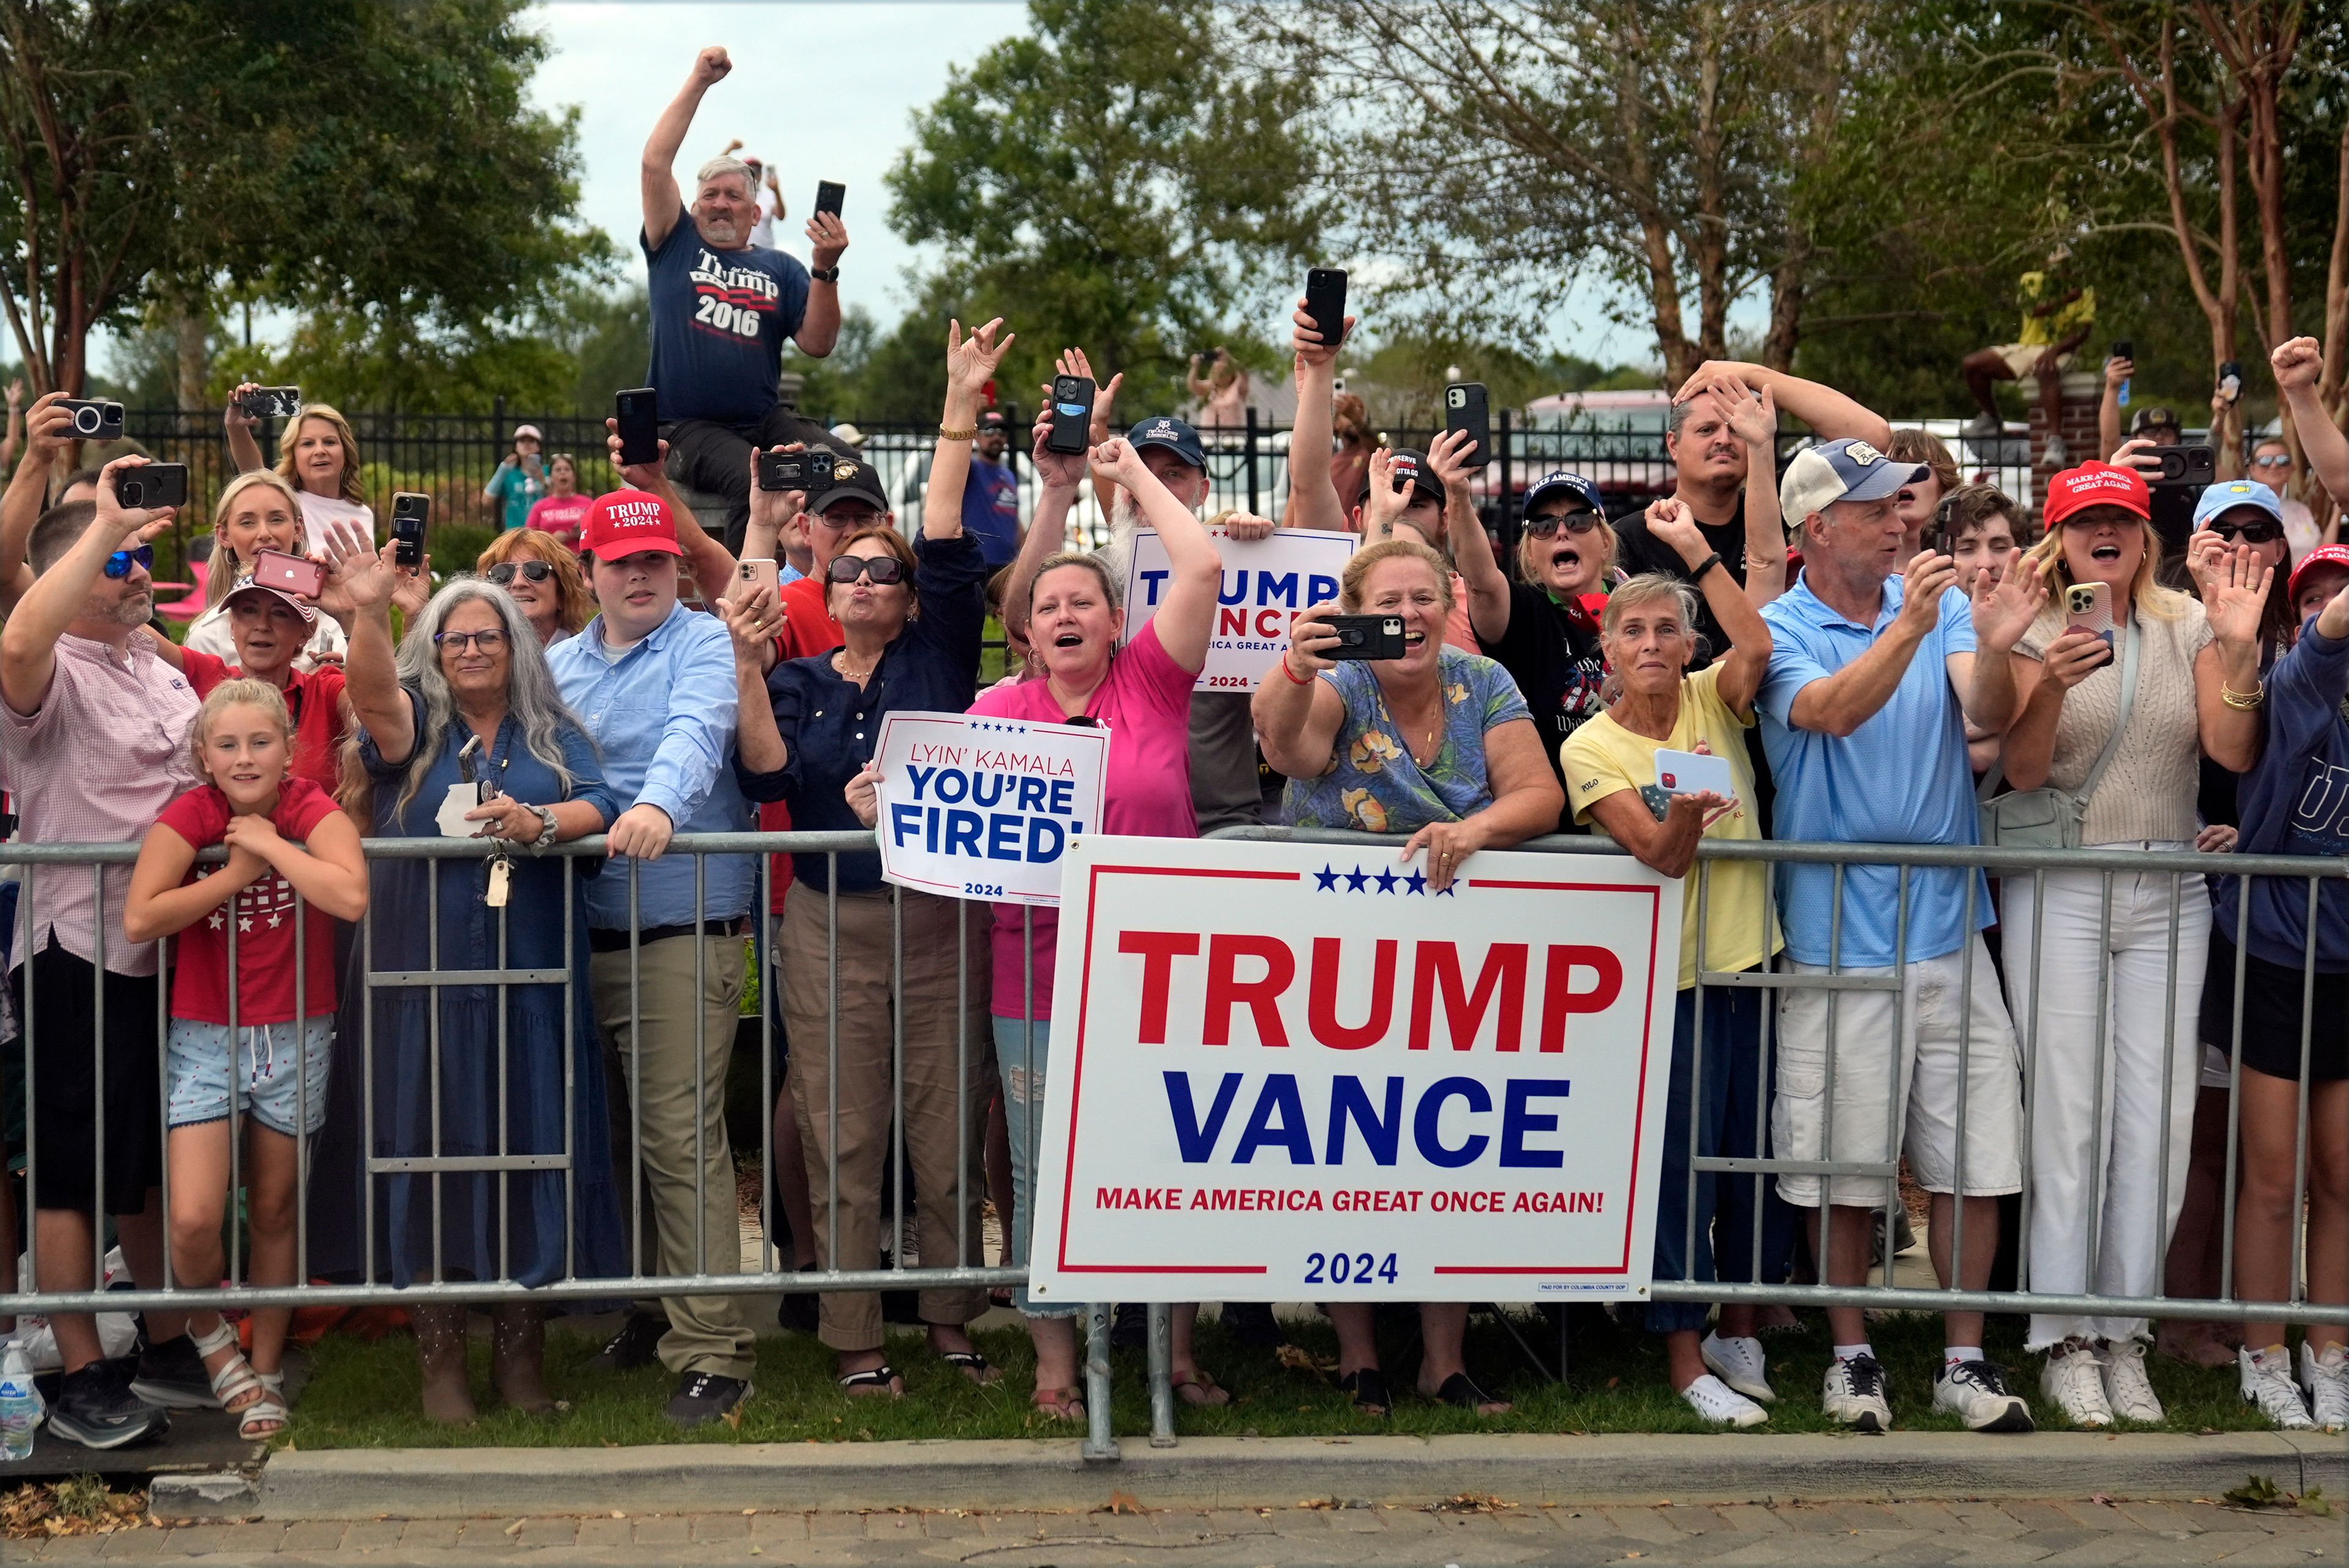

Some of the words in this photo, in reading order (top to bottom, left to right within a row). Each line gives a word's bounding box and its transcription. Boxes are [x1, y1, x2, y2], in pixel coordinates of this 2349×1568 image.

[697, 248, 779, 301] Trump
[742, 267, 771, 280] President
[696, 295, 760, 337] 2016
[1529, 476, 1549, 497] MAKE
[1551, 474, 1589, 489] AMERICA
[2066, 475, 2094, 487] MAKE
[2094, 471, 2134, 484] AMERICA
[2072, 480, 2103, 494] GREAT
[2103, 479, 2132, 491] AGAIN
[606, 501, 661, 519] TRUMP
[622, 516, 654, 528] 2024
[1140, 569, 1340, 608] TUMP
[1237, 642, 1275, 651] GREAT
[1577, 657, 1600, 675] the
[1209, 676, 1248, 687] 2024
[910, 743, 968, 766] LYIN'
[976, 749, 1074, 777] KAMALA
[905, 764, 1075, 815] YOU'RE
[1581, 778, 1598, 792] POLO
[1733, 811, 1744, 819] RL
[891, 802, 1083, 864] FIRED
[965, 882, 1003, 897] 2024
[1118, 930, 1623, 1053] TRUMP
[1163, 1071, 1570, 1169] VANCE
[1096, 1188, 1183, 1210] MAKE
[1190, 1188, 1324, 1211] AMERICA
[1332, 1190, 1423, 1213] GREAT
[1431, 1191, 1505, 1213] ONCE
[1513, 1192, 1604, 1214] AGAIN!
[1304, 1253, 1399, 1284] 2024
